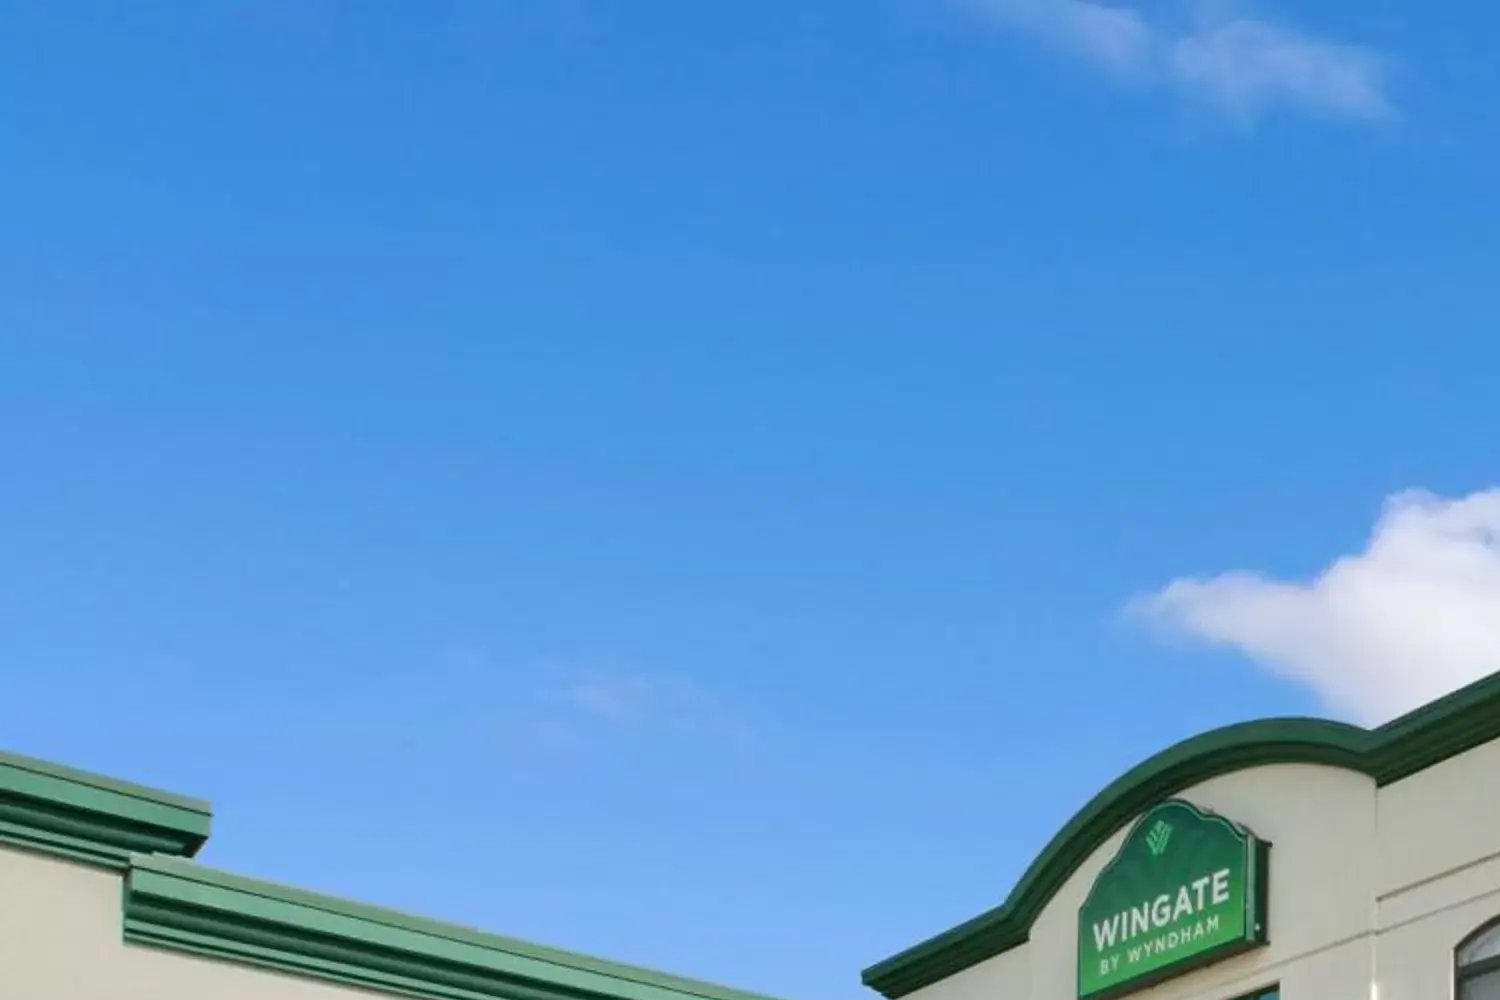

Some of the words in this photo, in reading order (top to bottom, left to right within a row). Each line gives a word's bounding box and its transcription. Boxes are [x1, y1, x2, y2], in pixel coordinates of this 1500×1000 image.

[1093, 868, 1230, 952] WINGATE
[1100, 954, 1120, 975] BY
[1127, 915, 1219, 963] WYNDHAM
